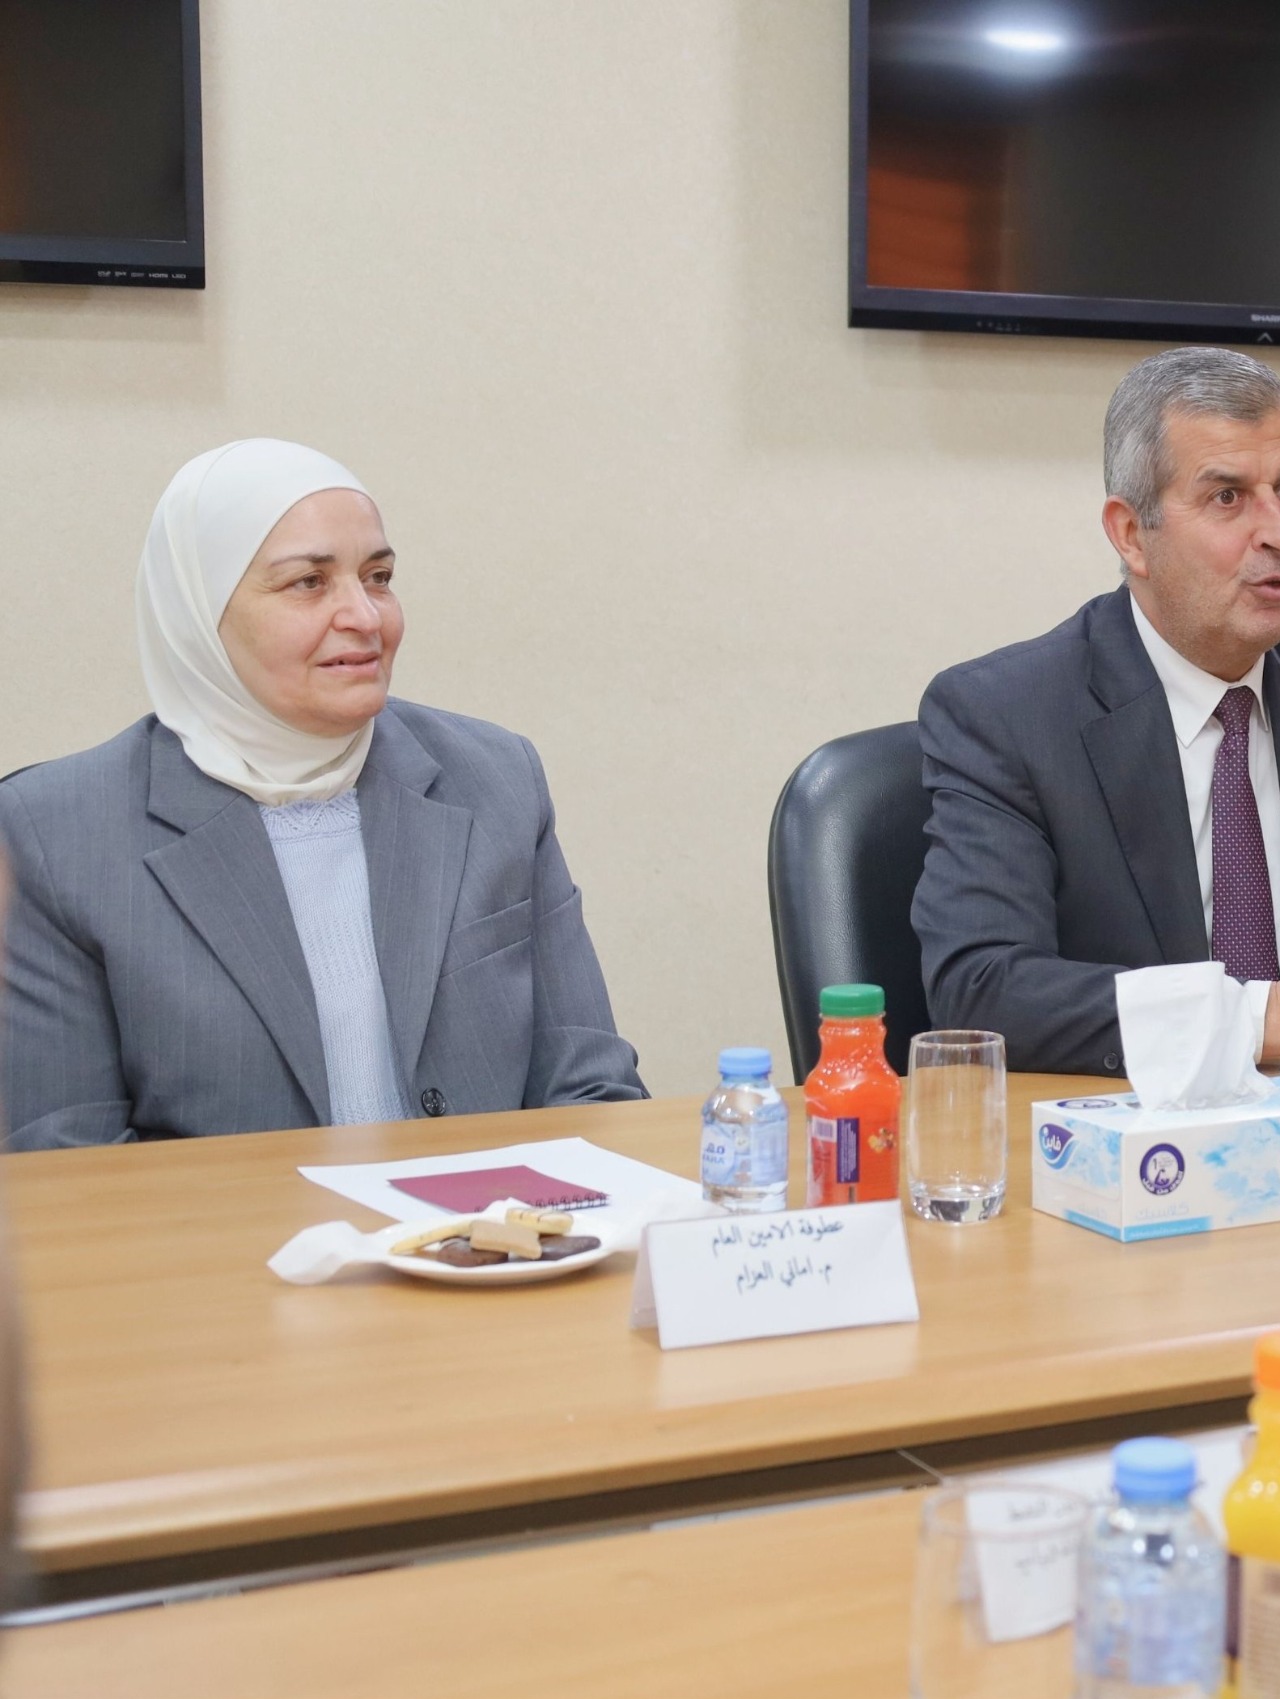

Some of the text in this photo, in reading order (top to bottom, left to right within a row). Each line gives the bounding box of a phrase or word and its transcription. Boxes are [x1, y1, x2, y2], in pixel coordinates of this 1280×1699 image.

[1042, 1126, 1062, 1153] فاين
[712, 1224, 742, 1259] العام
[798, 1215, 843, 1241] عطوفة
